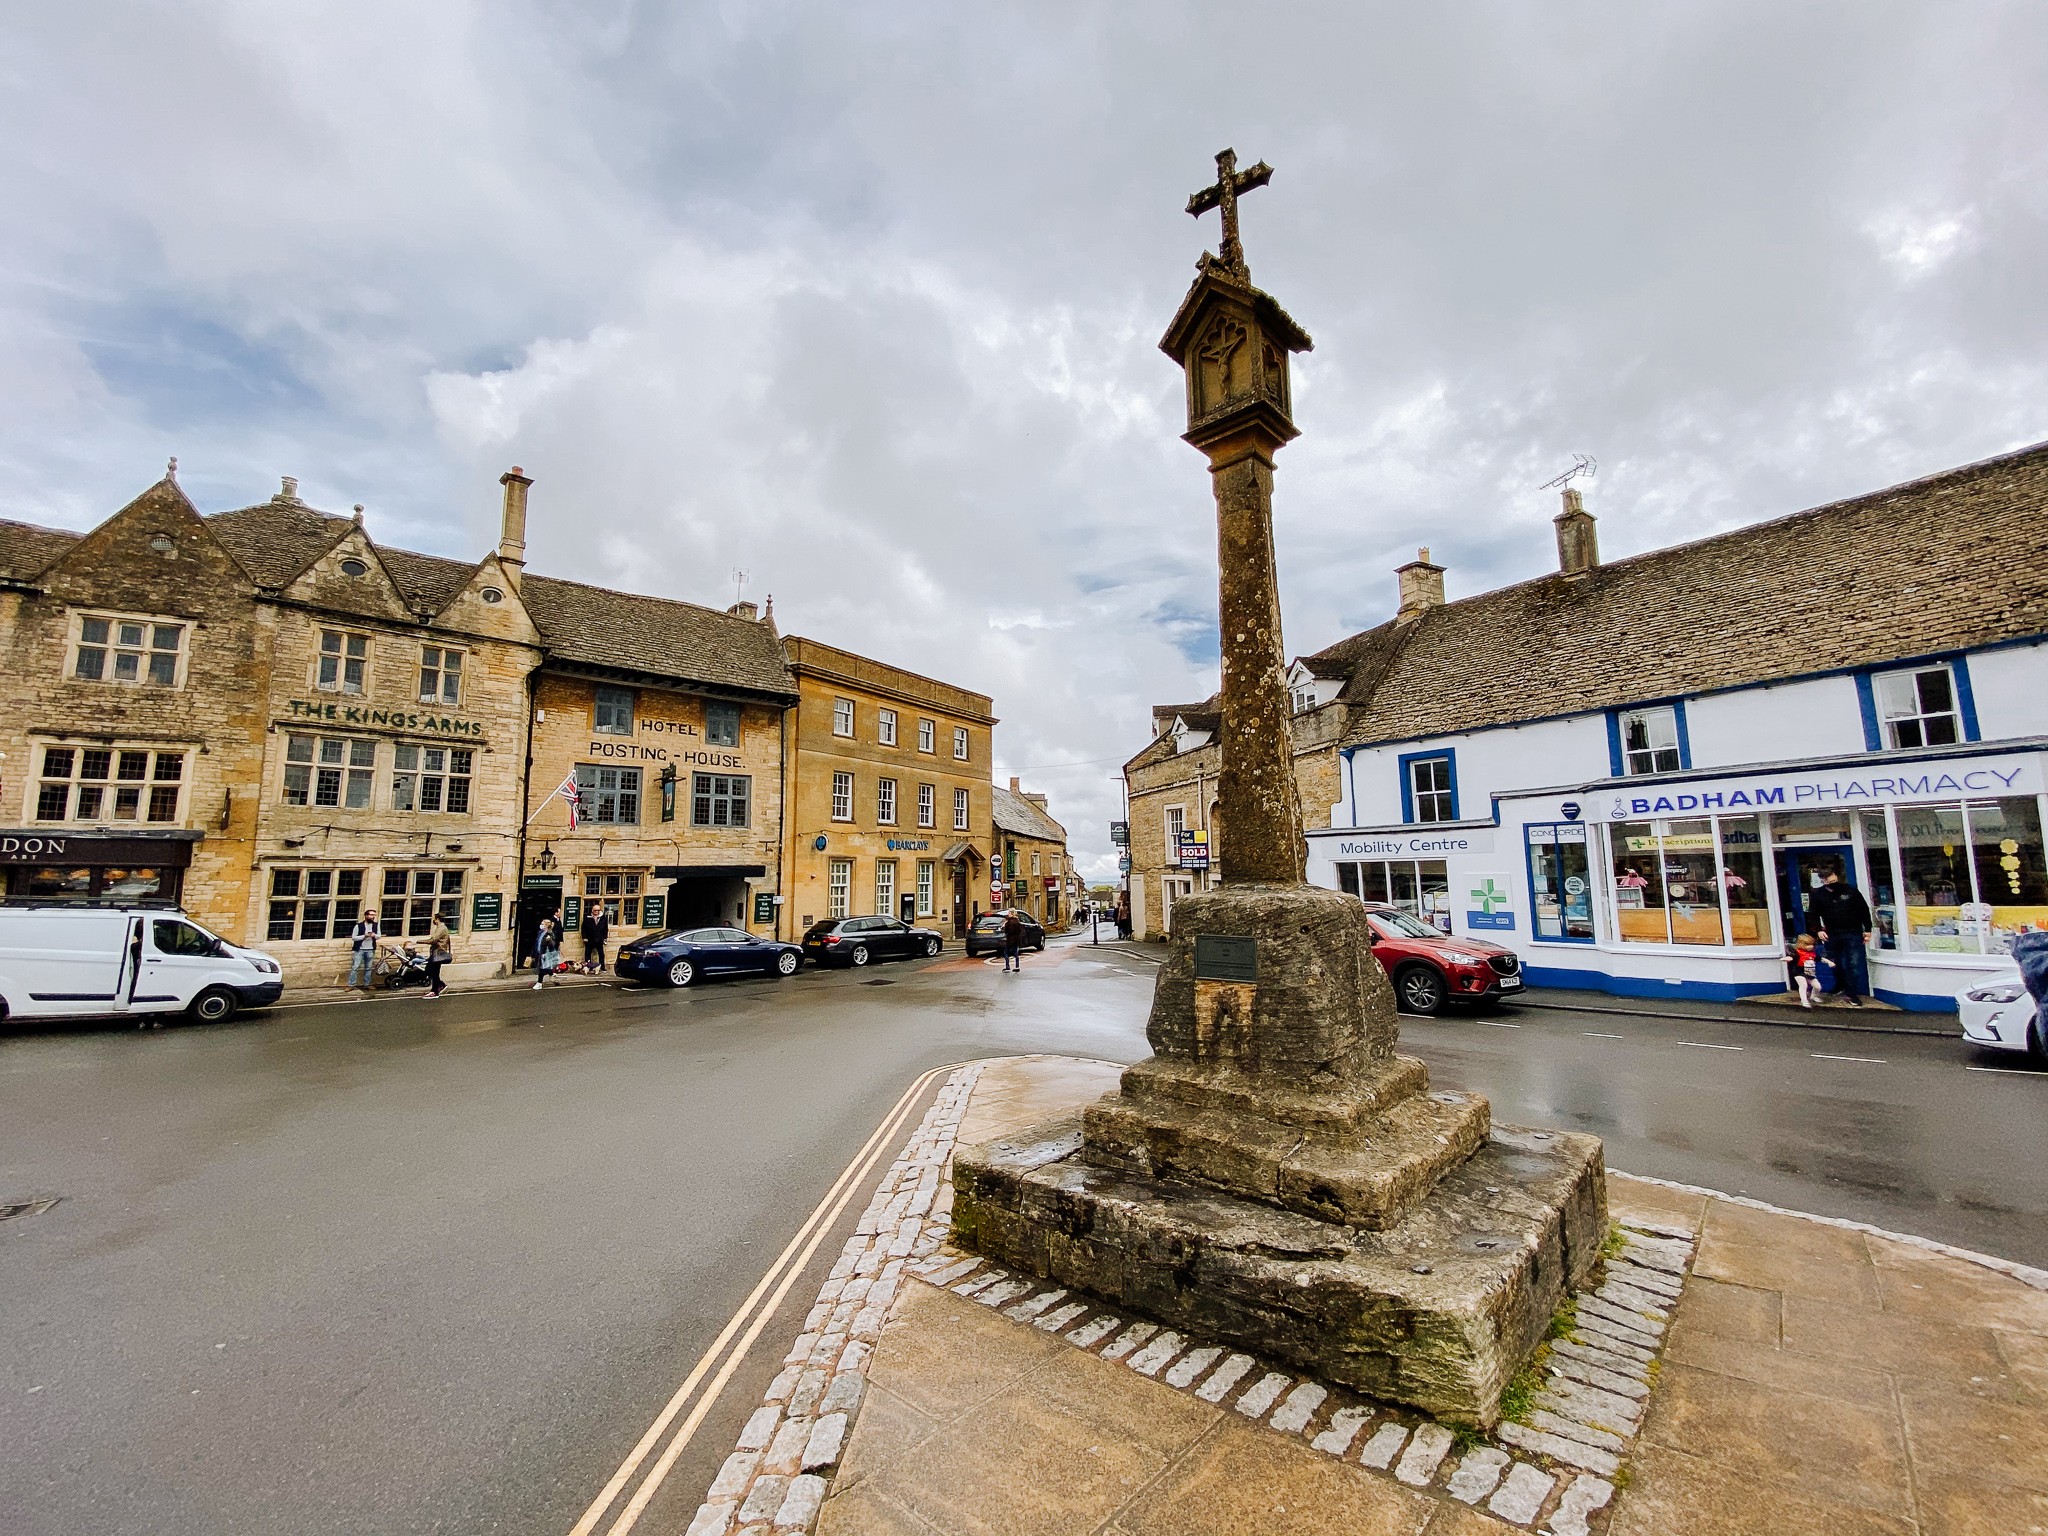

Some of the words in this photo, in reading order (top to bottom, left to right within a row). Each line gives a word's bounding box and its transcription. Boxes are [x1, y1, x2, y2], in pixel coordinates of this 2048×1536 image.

[290, 700, 337, 719] THE
[346, 707, 417, 727] KINGS
[425, 717, 481, 735] ARMS
[642, 719, 698, 736] HOTEL
[589, 742, 667, 761] POSTING
[1631, 787, 1785, 814] BADHAM
[1794, 767, 2021, 802] PHARMACY
[1530, 828, 1584, 837] CONCORDE
[1722, 830, 1760, 845] adha
[1, 838, 66, 854] DON
[895, 840, 929, 851] BARCLAYS
[1182, 849, 1207, 857] SOLD
[1340, 841, 1403, 854] Mobility
[1409, 838, 1468, 852] Centre
